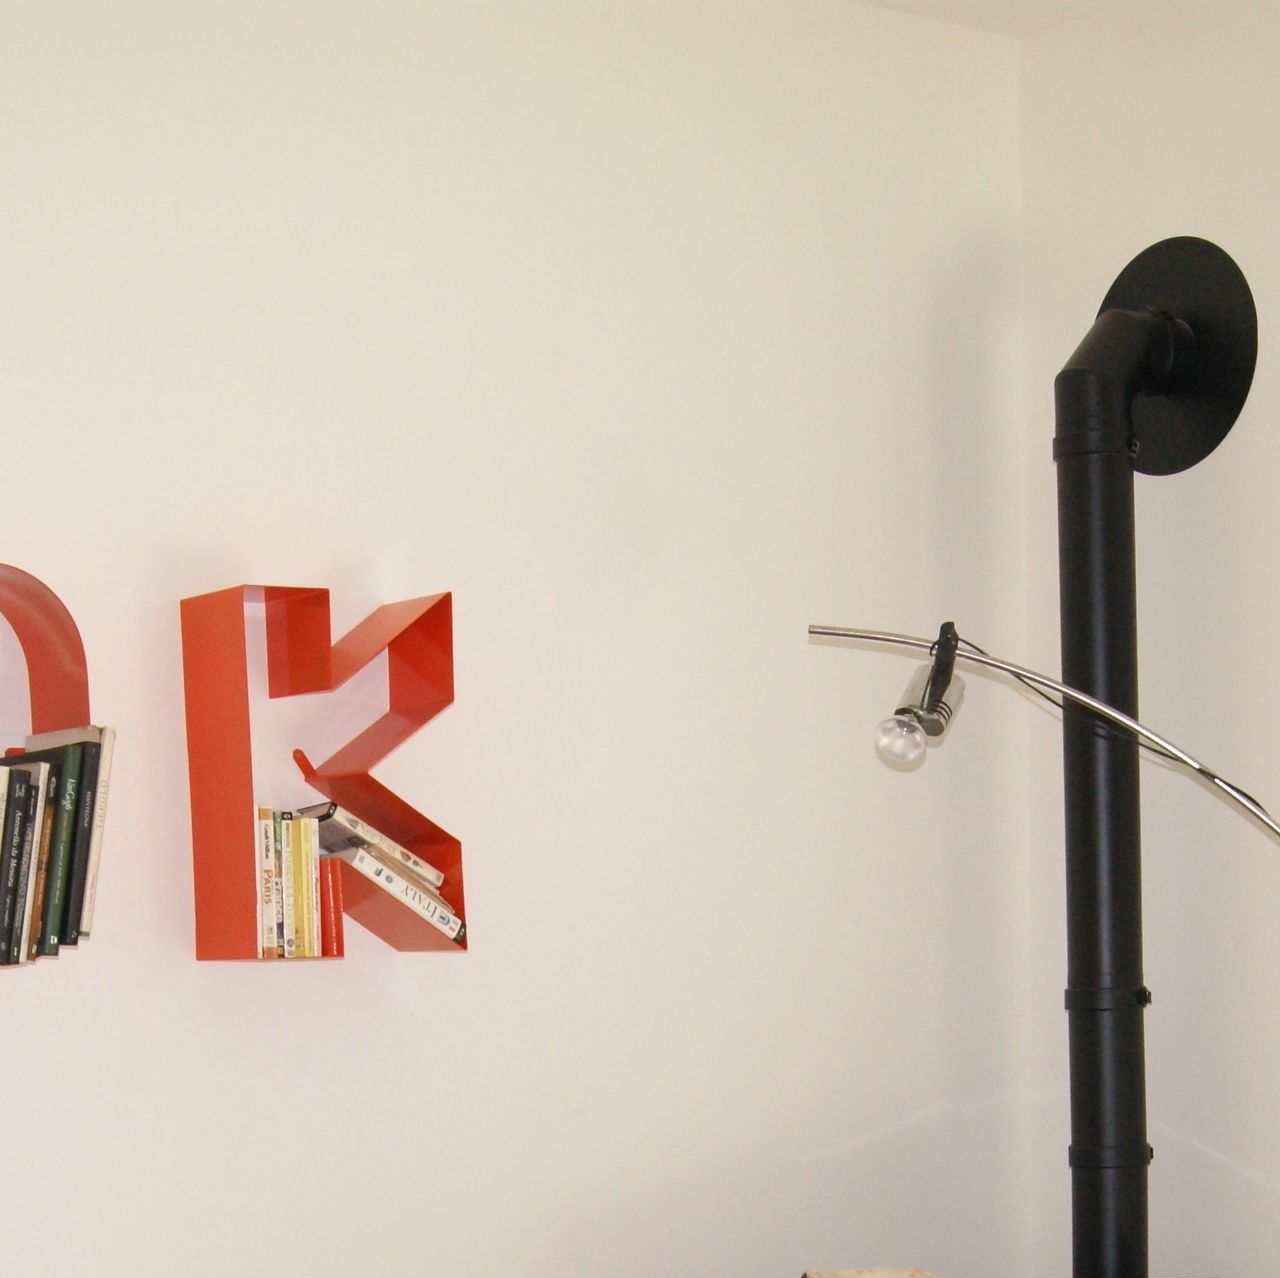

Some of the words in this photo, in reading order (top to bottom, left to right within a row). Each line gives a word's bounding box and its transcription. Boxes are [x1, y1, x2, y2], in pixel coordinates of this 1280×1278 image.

[96, 780, 107, 828] TIEPOLO
[12, 810, 22, 846] Antonello
[11, 847, 18, 856] da
[7, 858, 17, 887] Messina
[263, 869, 272, 905] PARIS
[401, 884, 436, 918] ITALY
